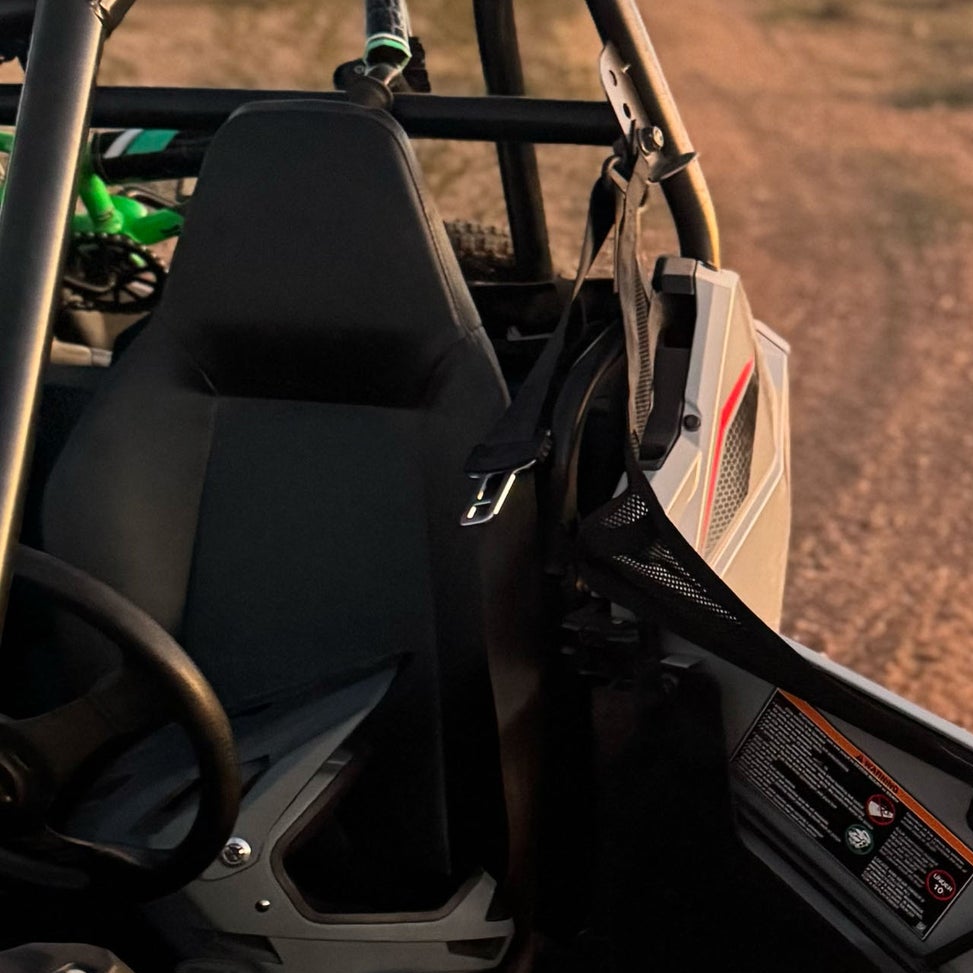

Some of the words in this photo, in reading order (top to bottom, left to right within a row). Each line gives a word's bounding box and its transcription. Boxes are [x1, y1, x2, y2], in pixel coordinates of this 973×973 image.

[863, 759, 900, 794] WARNING
[933, 872, 954, 893] UNDER
[933, 883, 944, 894] 10
